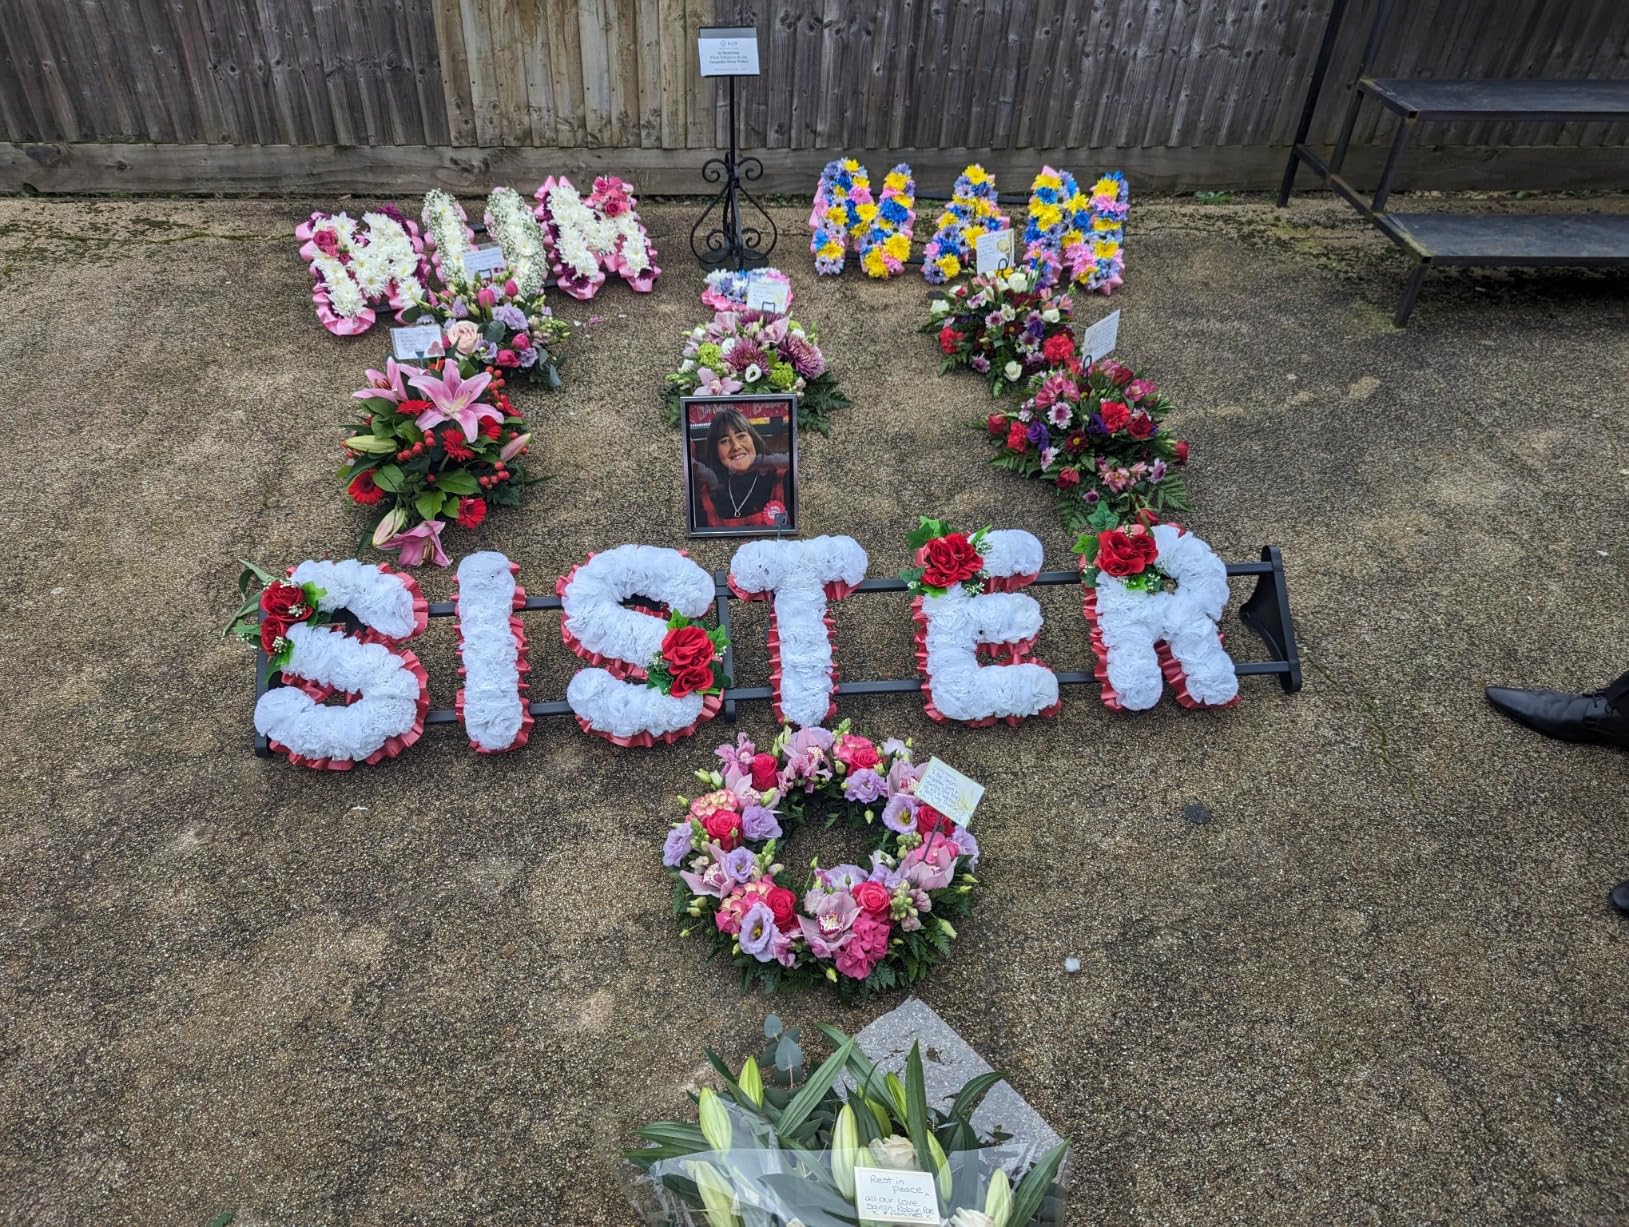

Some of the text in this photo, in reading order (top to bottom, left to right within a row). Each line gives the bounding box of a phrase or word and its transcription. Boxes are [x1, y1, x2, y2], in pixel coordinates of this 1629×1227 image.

[296, 175, 661, 336] MUM
[809, 157, 1130, 295] NAN
[253, 520, 1242, 772] SISTER
